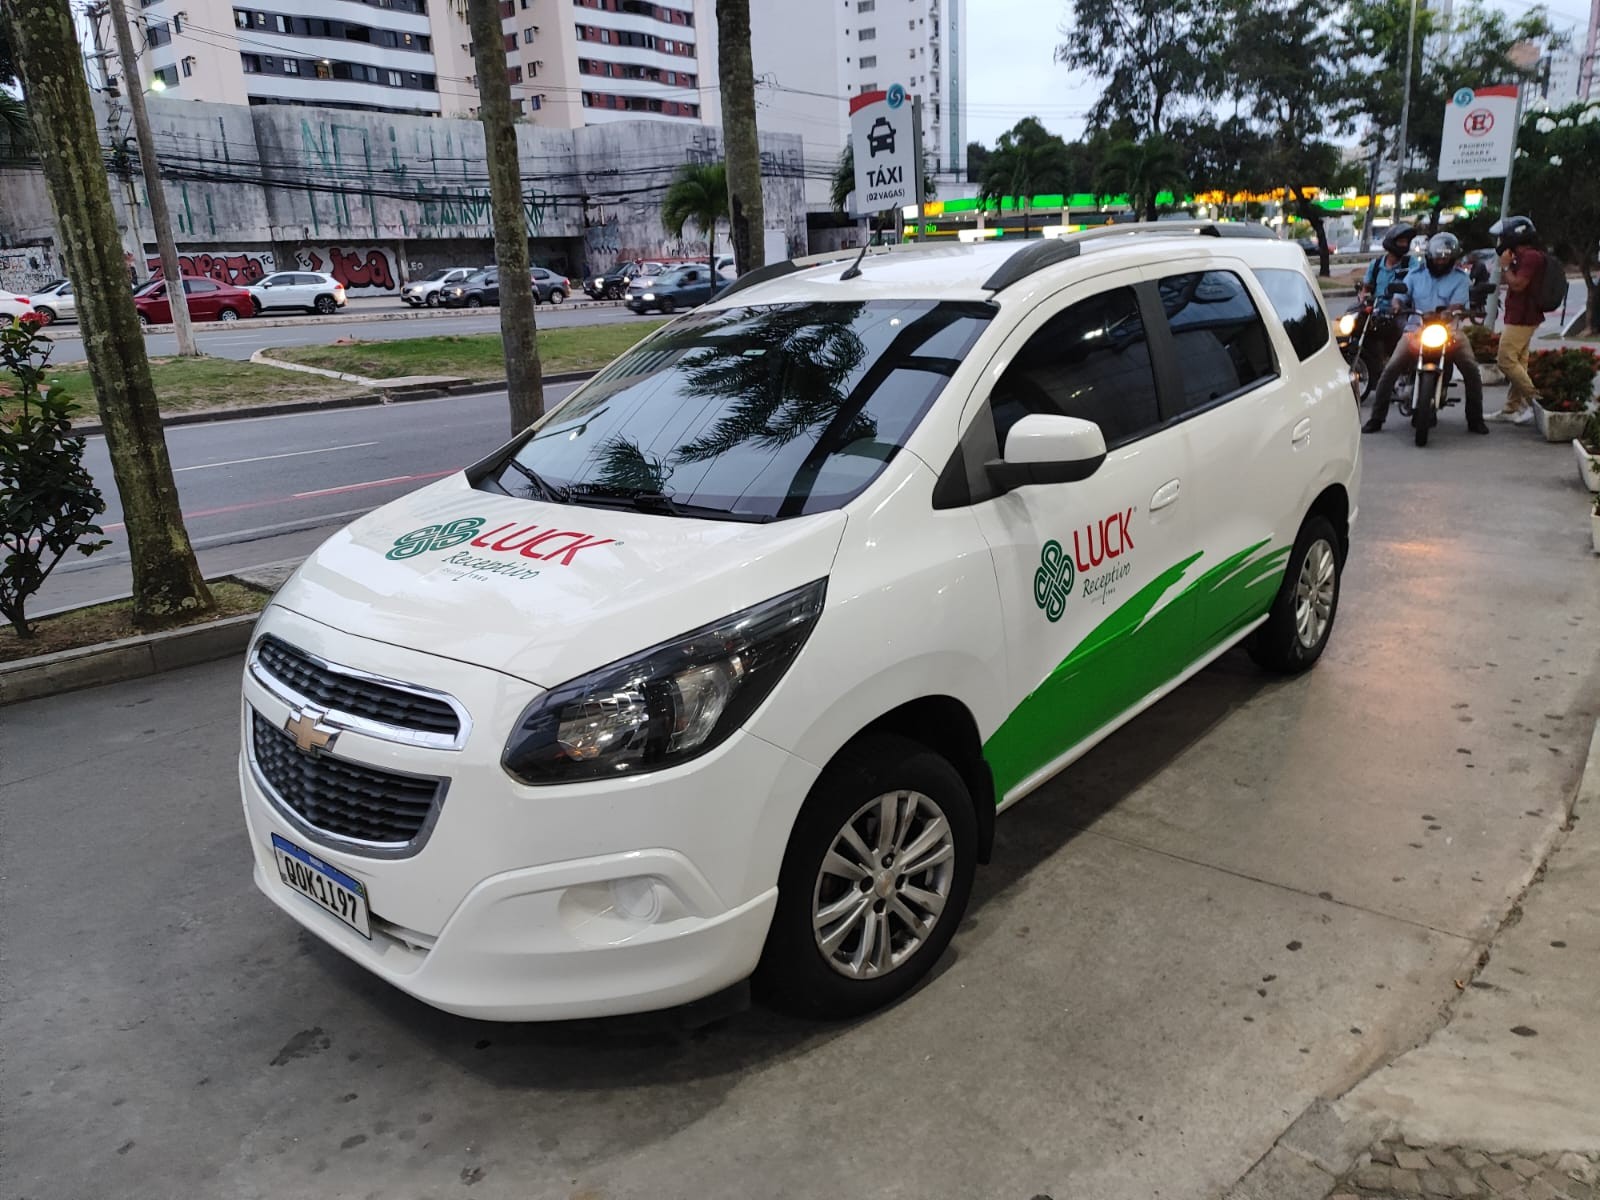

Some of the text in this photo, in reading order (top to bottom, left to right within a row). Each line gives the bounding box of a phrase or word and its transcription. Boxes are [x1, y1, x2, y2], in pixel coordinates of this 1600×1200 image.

[866, 164, 903, 188] TÁXI
[866, 188, 905, 203] (02 VAGAS)
[470, 522, 617, 566] LUCK
[1073, 507, 1134, 573] LUCK
[441, 550, 540, 582] Receptivo
[1082, 561, 1131, 605] Receptivo
